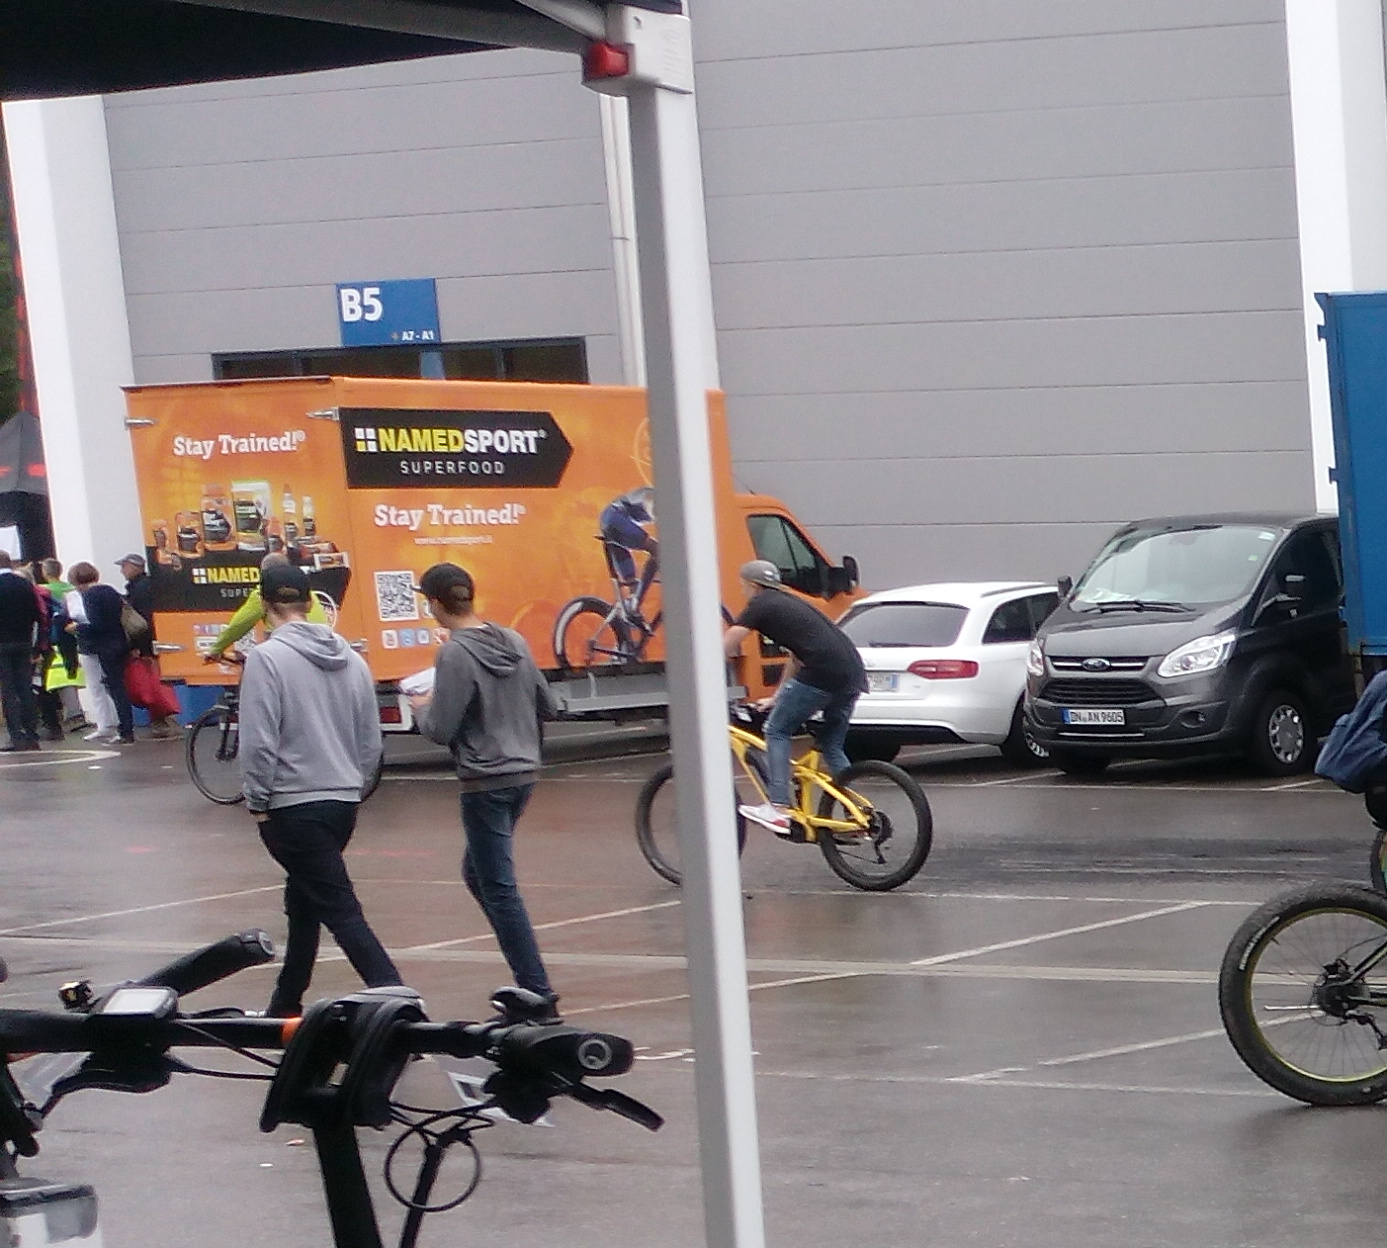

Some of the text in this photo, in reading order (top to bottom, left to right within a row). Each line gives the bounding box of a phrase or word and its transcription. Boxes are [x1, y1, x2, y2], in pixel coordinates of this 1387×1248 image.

[340, 287, 383, 322] B5
[173, 436, 214, 460] Stay
[400, 460, 505, 475] SUPERFOOD
[374, 504, 423, 531] Stay
